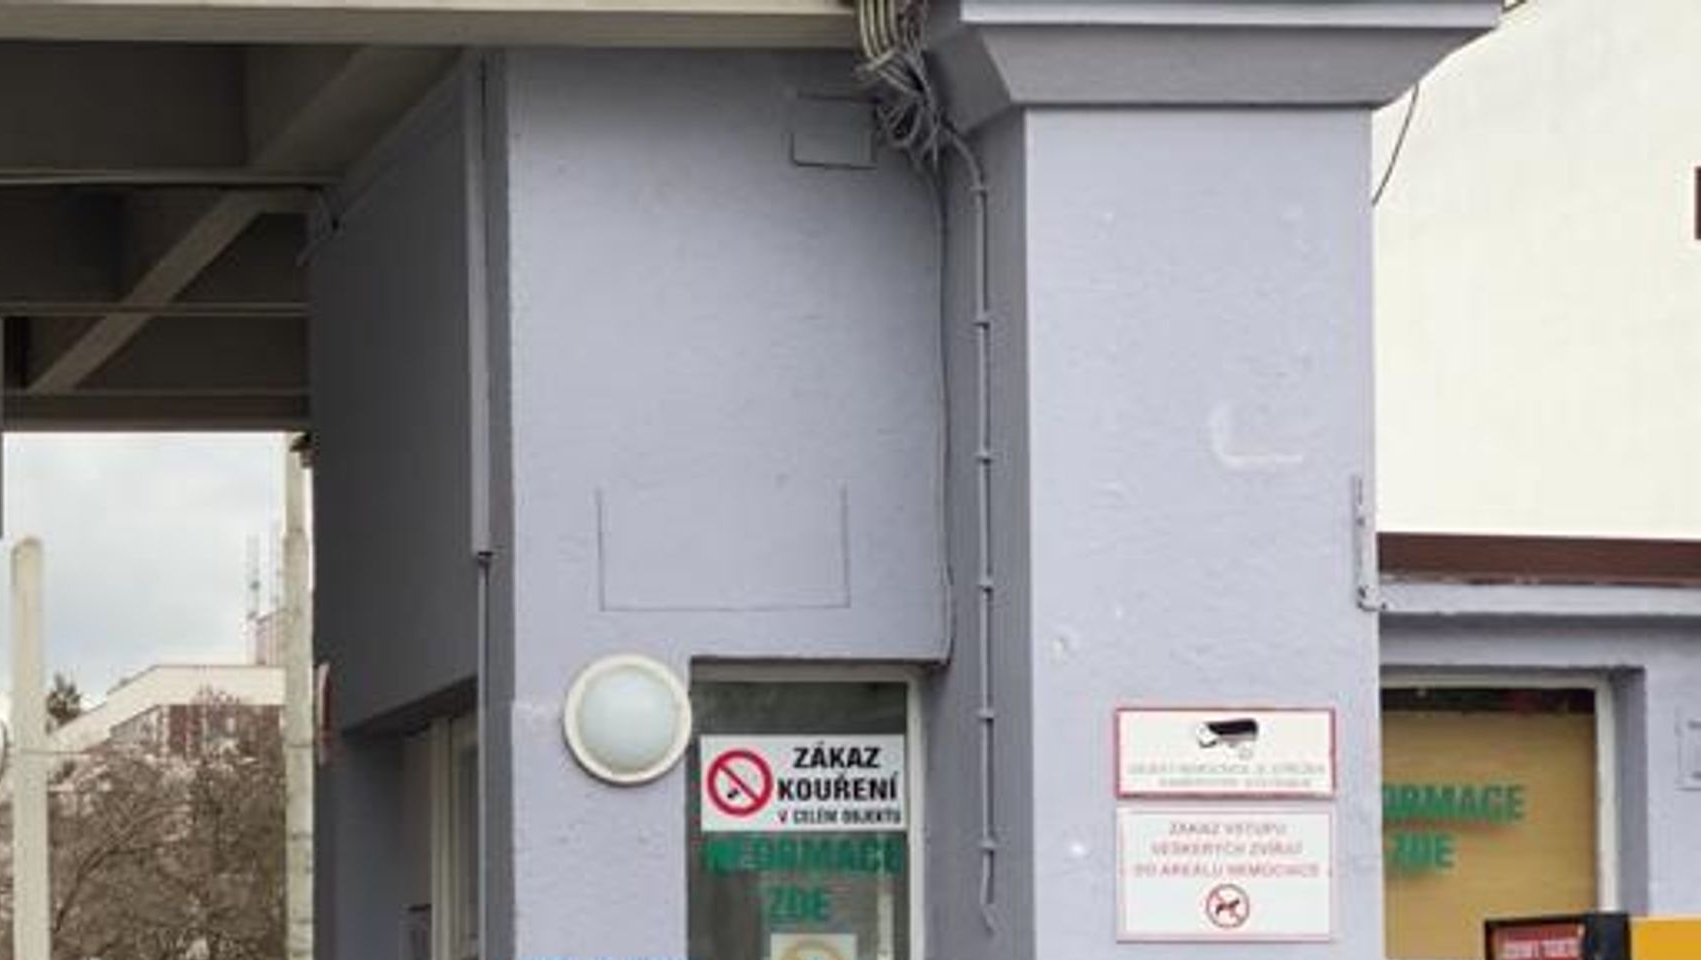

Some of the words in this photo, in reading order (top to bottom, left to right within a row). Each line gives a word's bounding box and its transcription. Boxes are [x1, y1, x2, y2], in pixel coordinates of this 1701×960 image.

[792, 742, 881, 769] ZÁKAZ
[777, 771, 899, 801] KOUŘENÍ
[778, 811, 788, 823] V
[793, 808, 838, 824] CELÉM
[842, 809, 901, 824] OBJEKTU
[768, 885, 833, 922] ZDE
